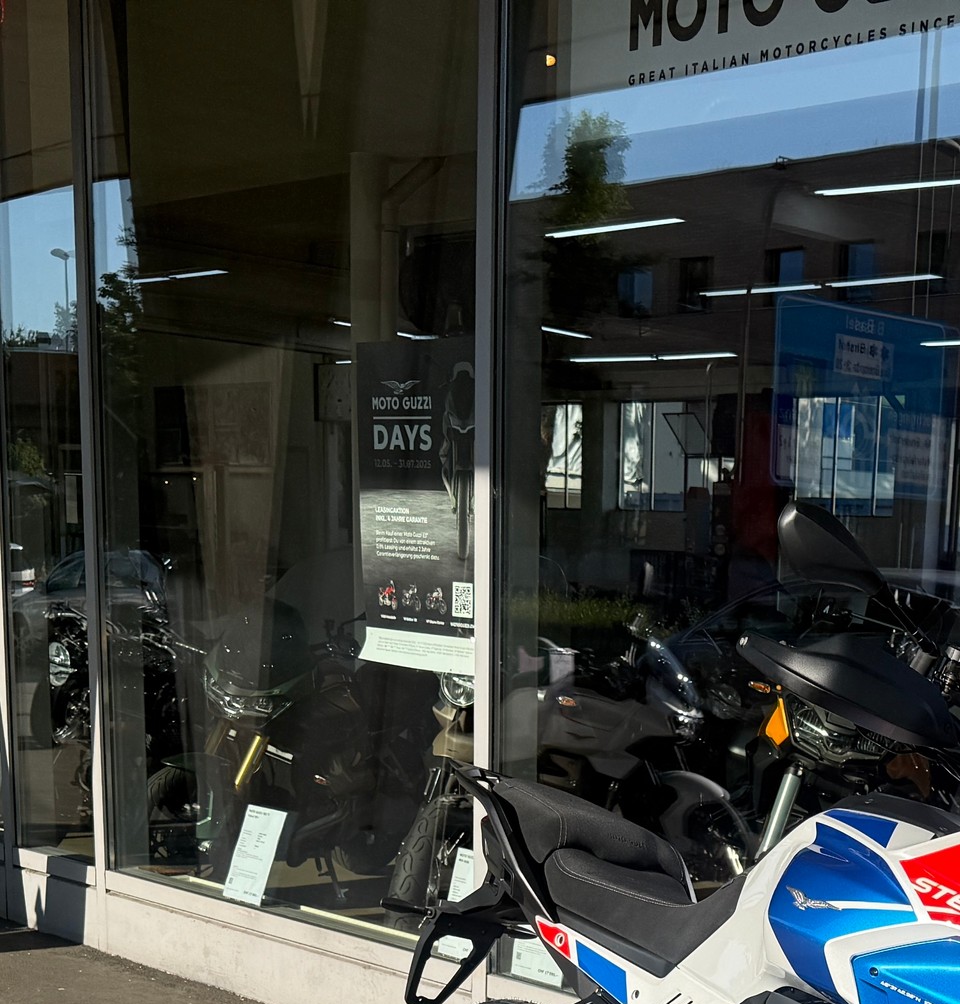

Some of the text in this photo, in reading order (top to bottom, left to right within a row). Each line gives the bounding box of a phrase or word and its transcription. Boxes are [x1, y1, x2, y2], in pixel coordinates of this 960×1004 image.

[628, 67, 676, 87] GREAT
[684, 52, 750, 75] ITALIAN
[759, 27, 889, 63] MOTORCYCLES
[898, 15, 956, 37] SINCE
[372, 396, 432, 410] MOTO GUZZI
[373, 424, 433, 451] DAYS
